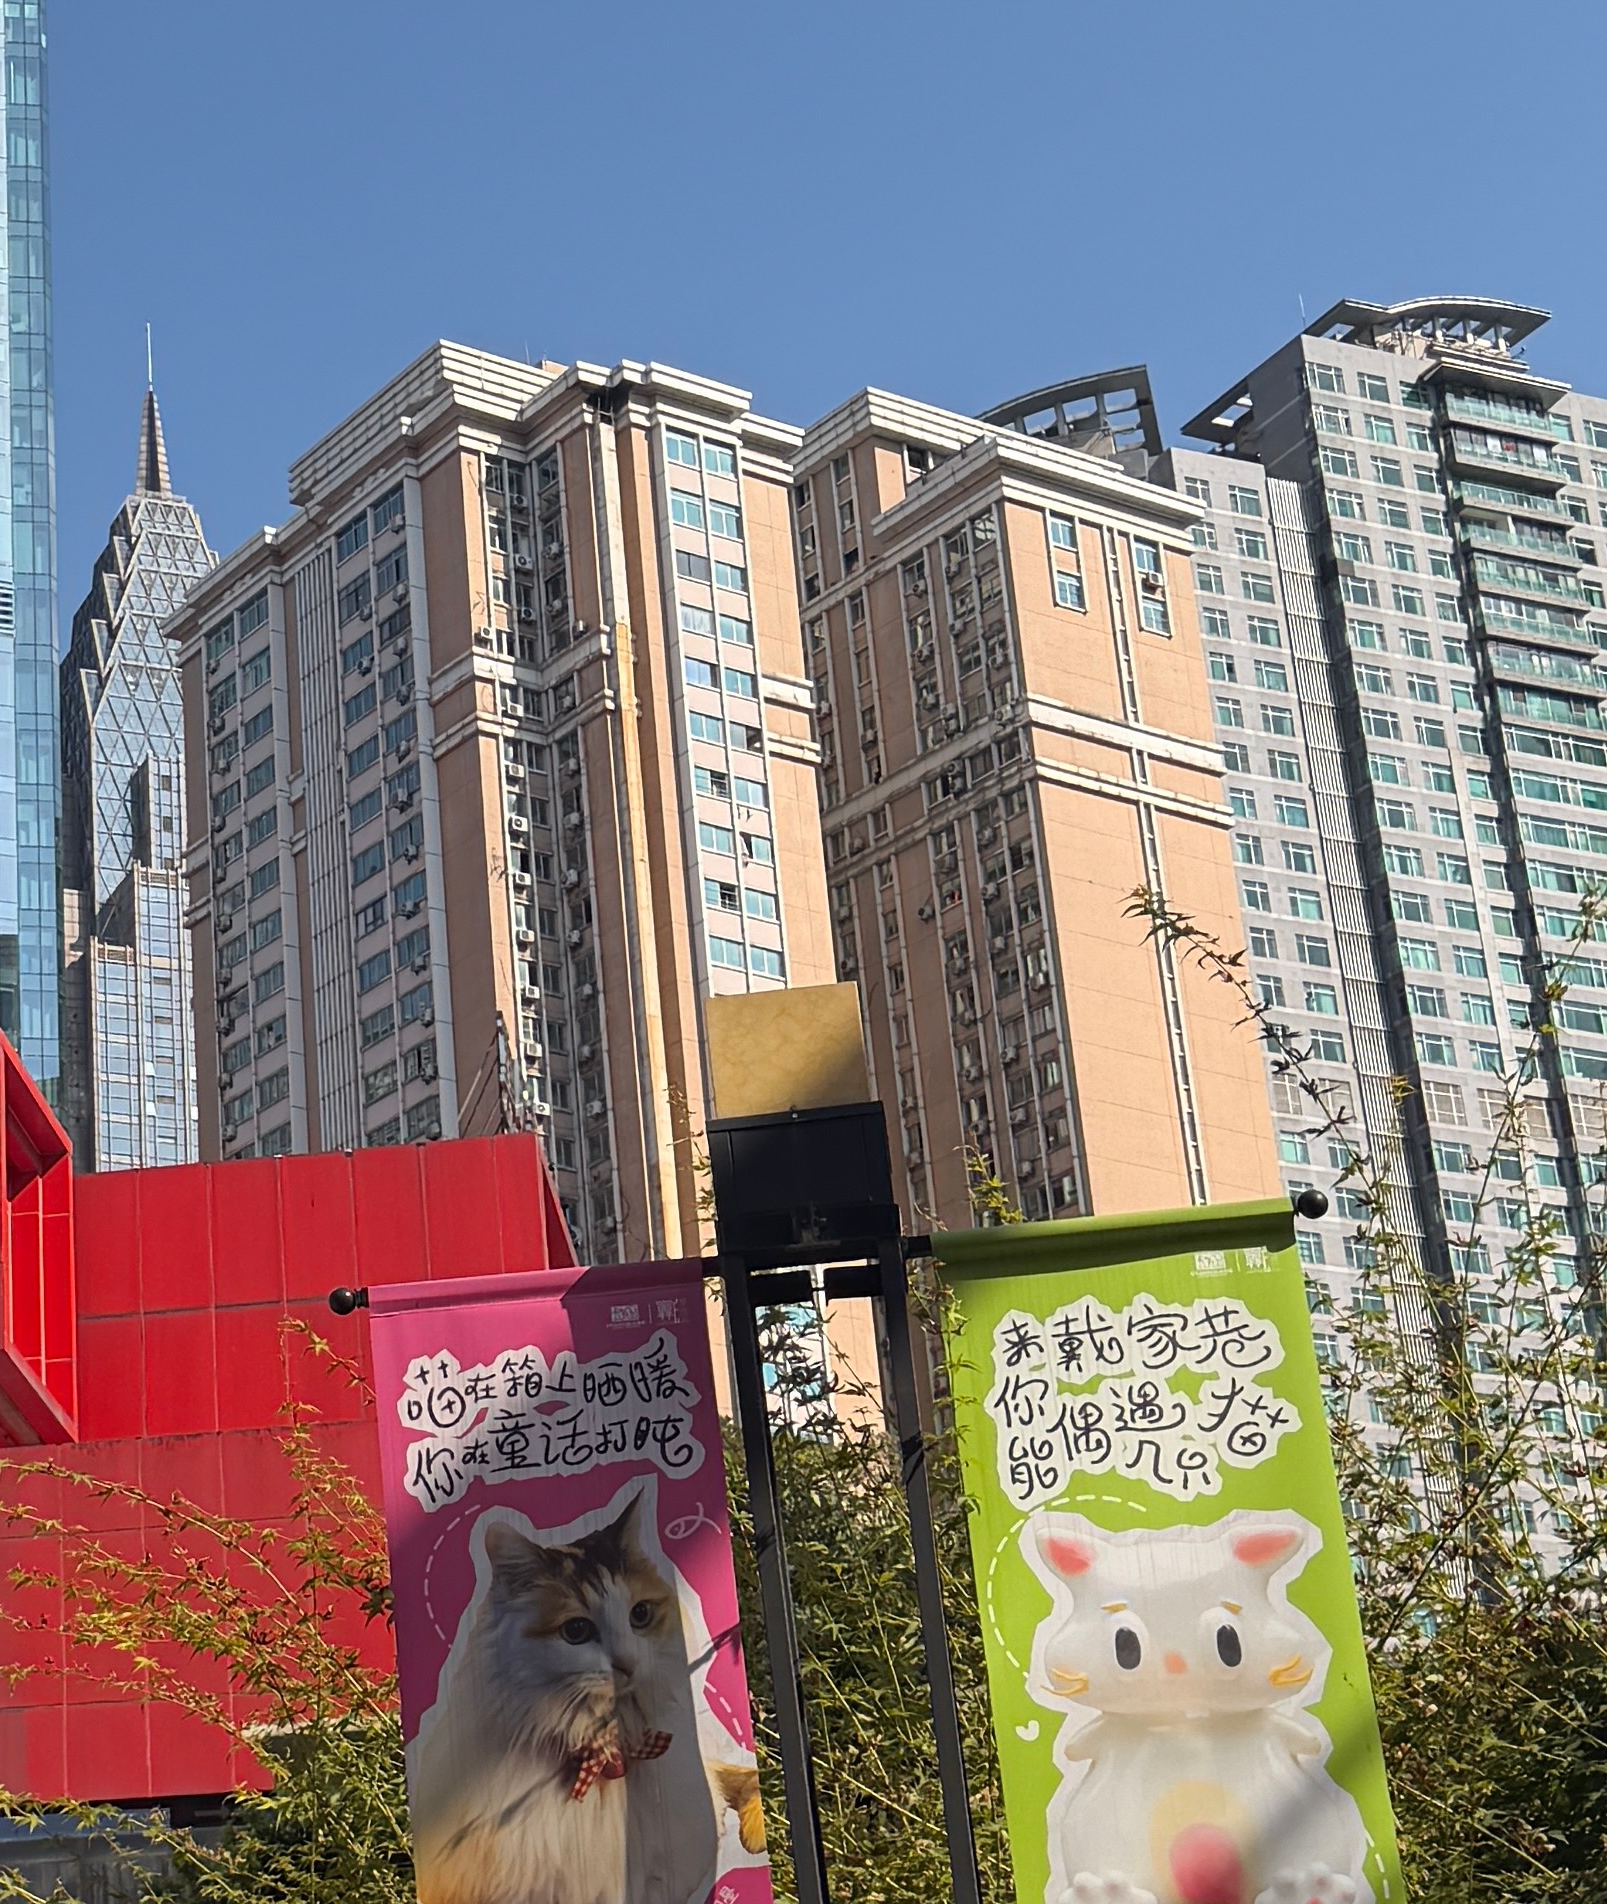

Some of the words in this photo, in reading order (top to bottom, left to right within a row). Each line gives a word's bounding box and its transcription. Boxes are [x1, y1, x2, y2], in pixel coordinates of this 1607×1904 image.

[999, 1303, 1272, 1373] 来戴家巷
[412, 1408, 694, 1504] 你在童话打盹
